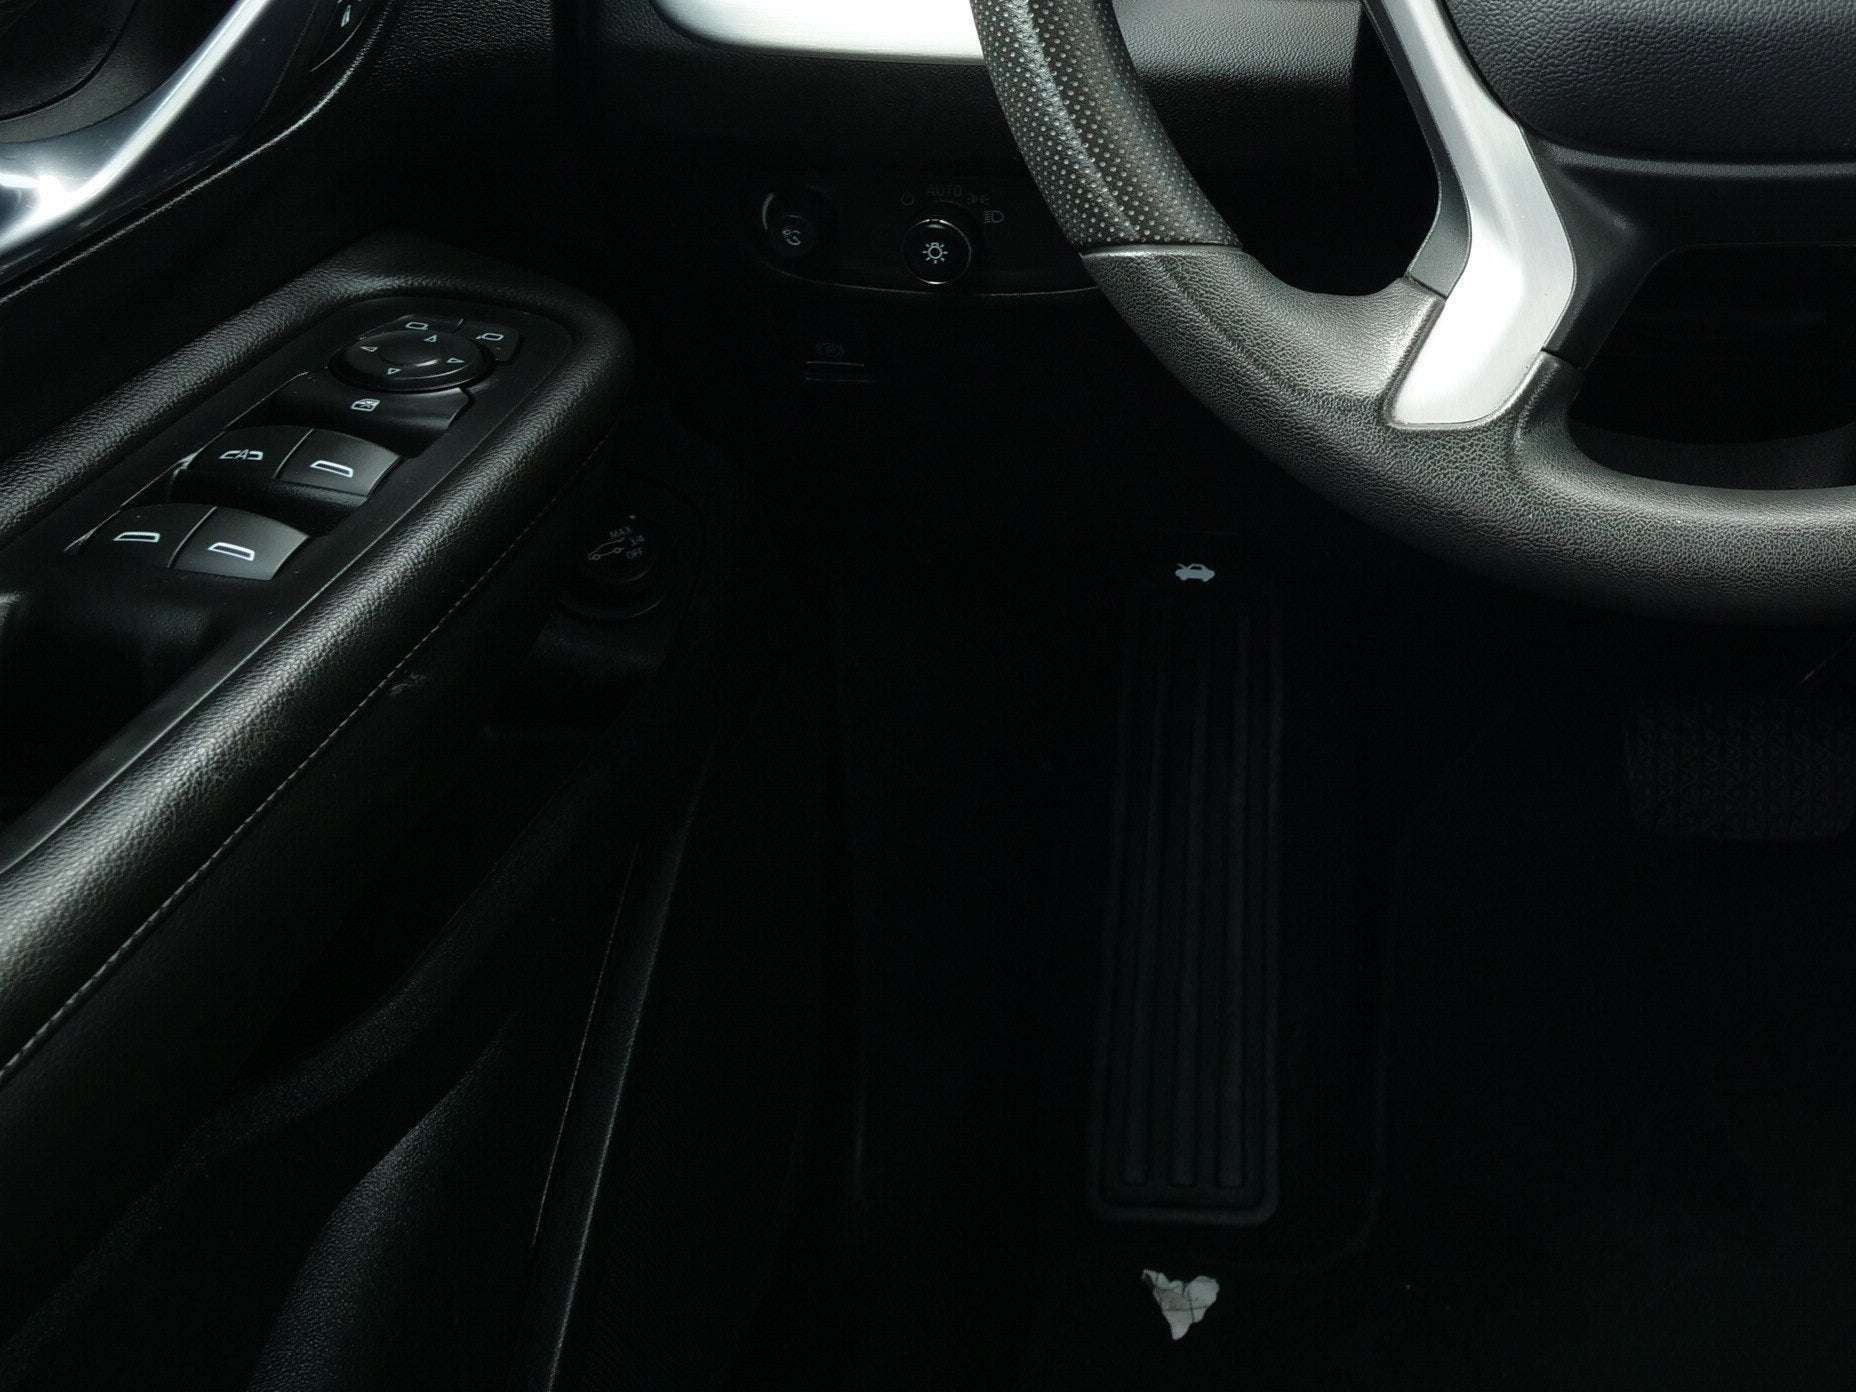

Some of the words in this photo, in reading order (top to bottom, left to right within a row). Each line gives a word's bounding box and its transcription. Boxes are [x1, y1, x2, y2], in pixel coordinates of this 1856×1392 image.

[927, 183, 963, 198] AUTO
[609, 525, 633, 540] MAX
[625, 546, 645, 561] OFF
